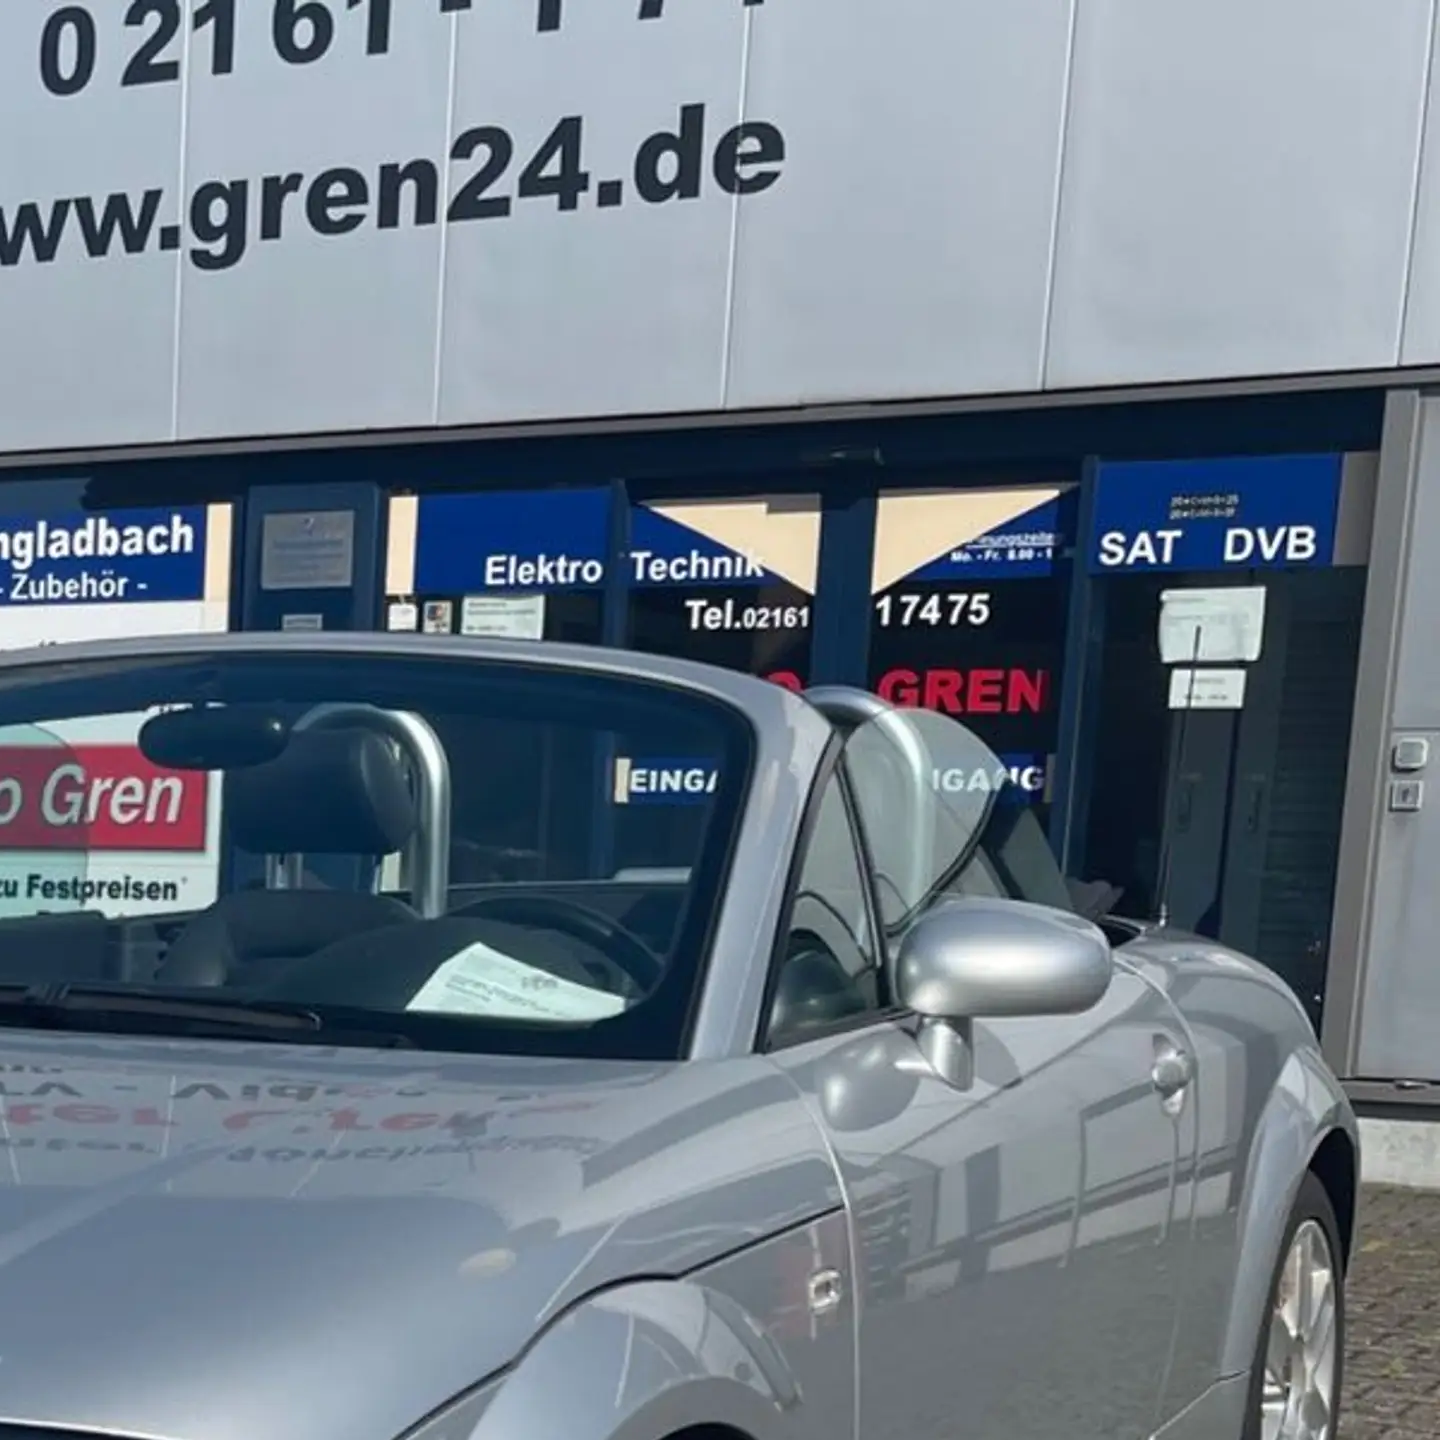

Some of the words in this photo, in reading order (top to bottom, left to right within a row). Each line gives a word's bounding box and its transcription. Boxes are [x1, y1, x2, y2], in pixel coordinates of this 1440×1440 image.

[1099, 529, 1183, 566] SAT
[1223, 525, 1317, 562] DVB
[484, 554, 603, 585] Elektro
[630, 549, 765, 581] Technik
[10, 569, 129, 602] Zubehör
[875, 592, 991, 627] 17475
[878, 668, 1046, 712] GREN
[41, 763, 184, 827] Gren
[26, 873, 179, 906] Festpreisen
